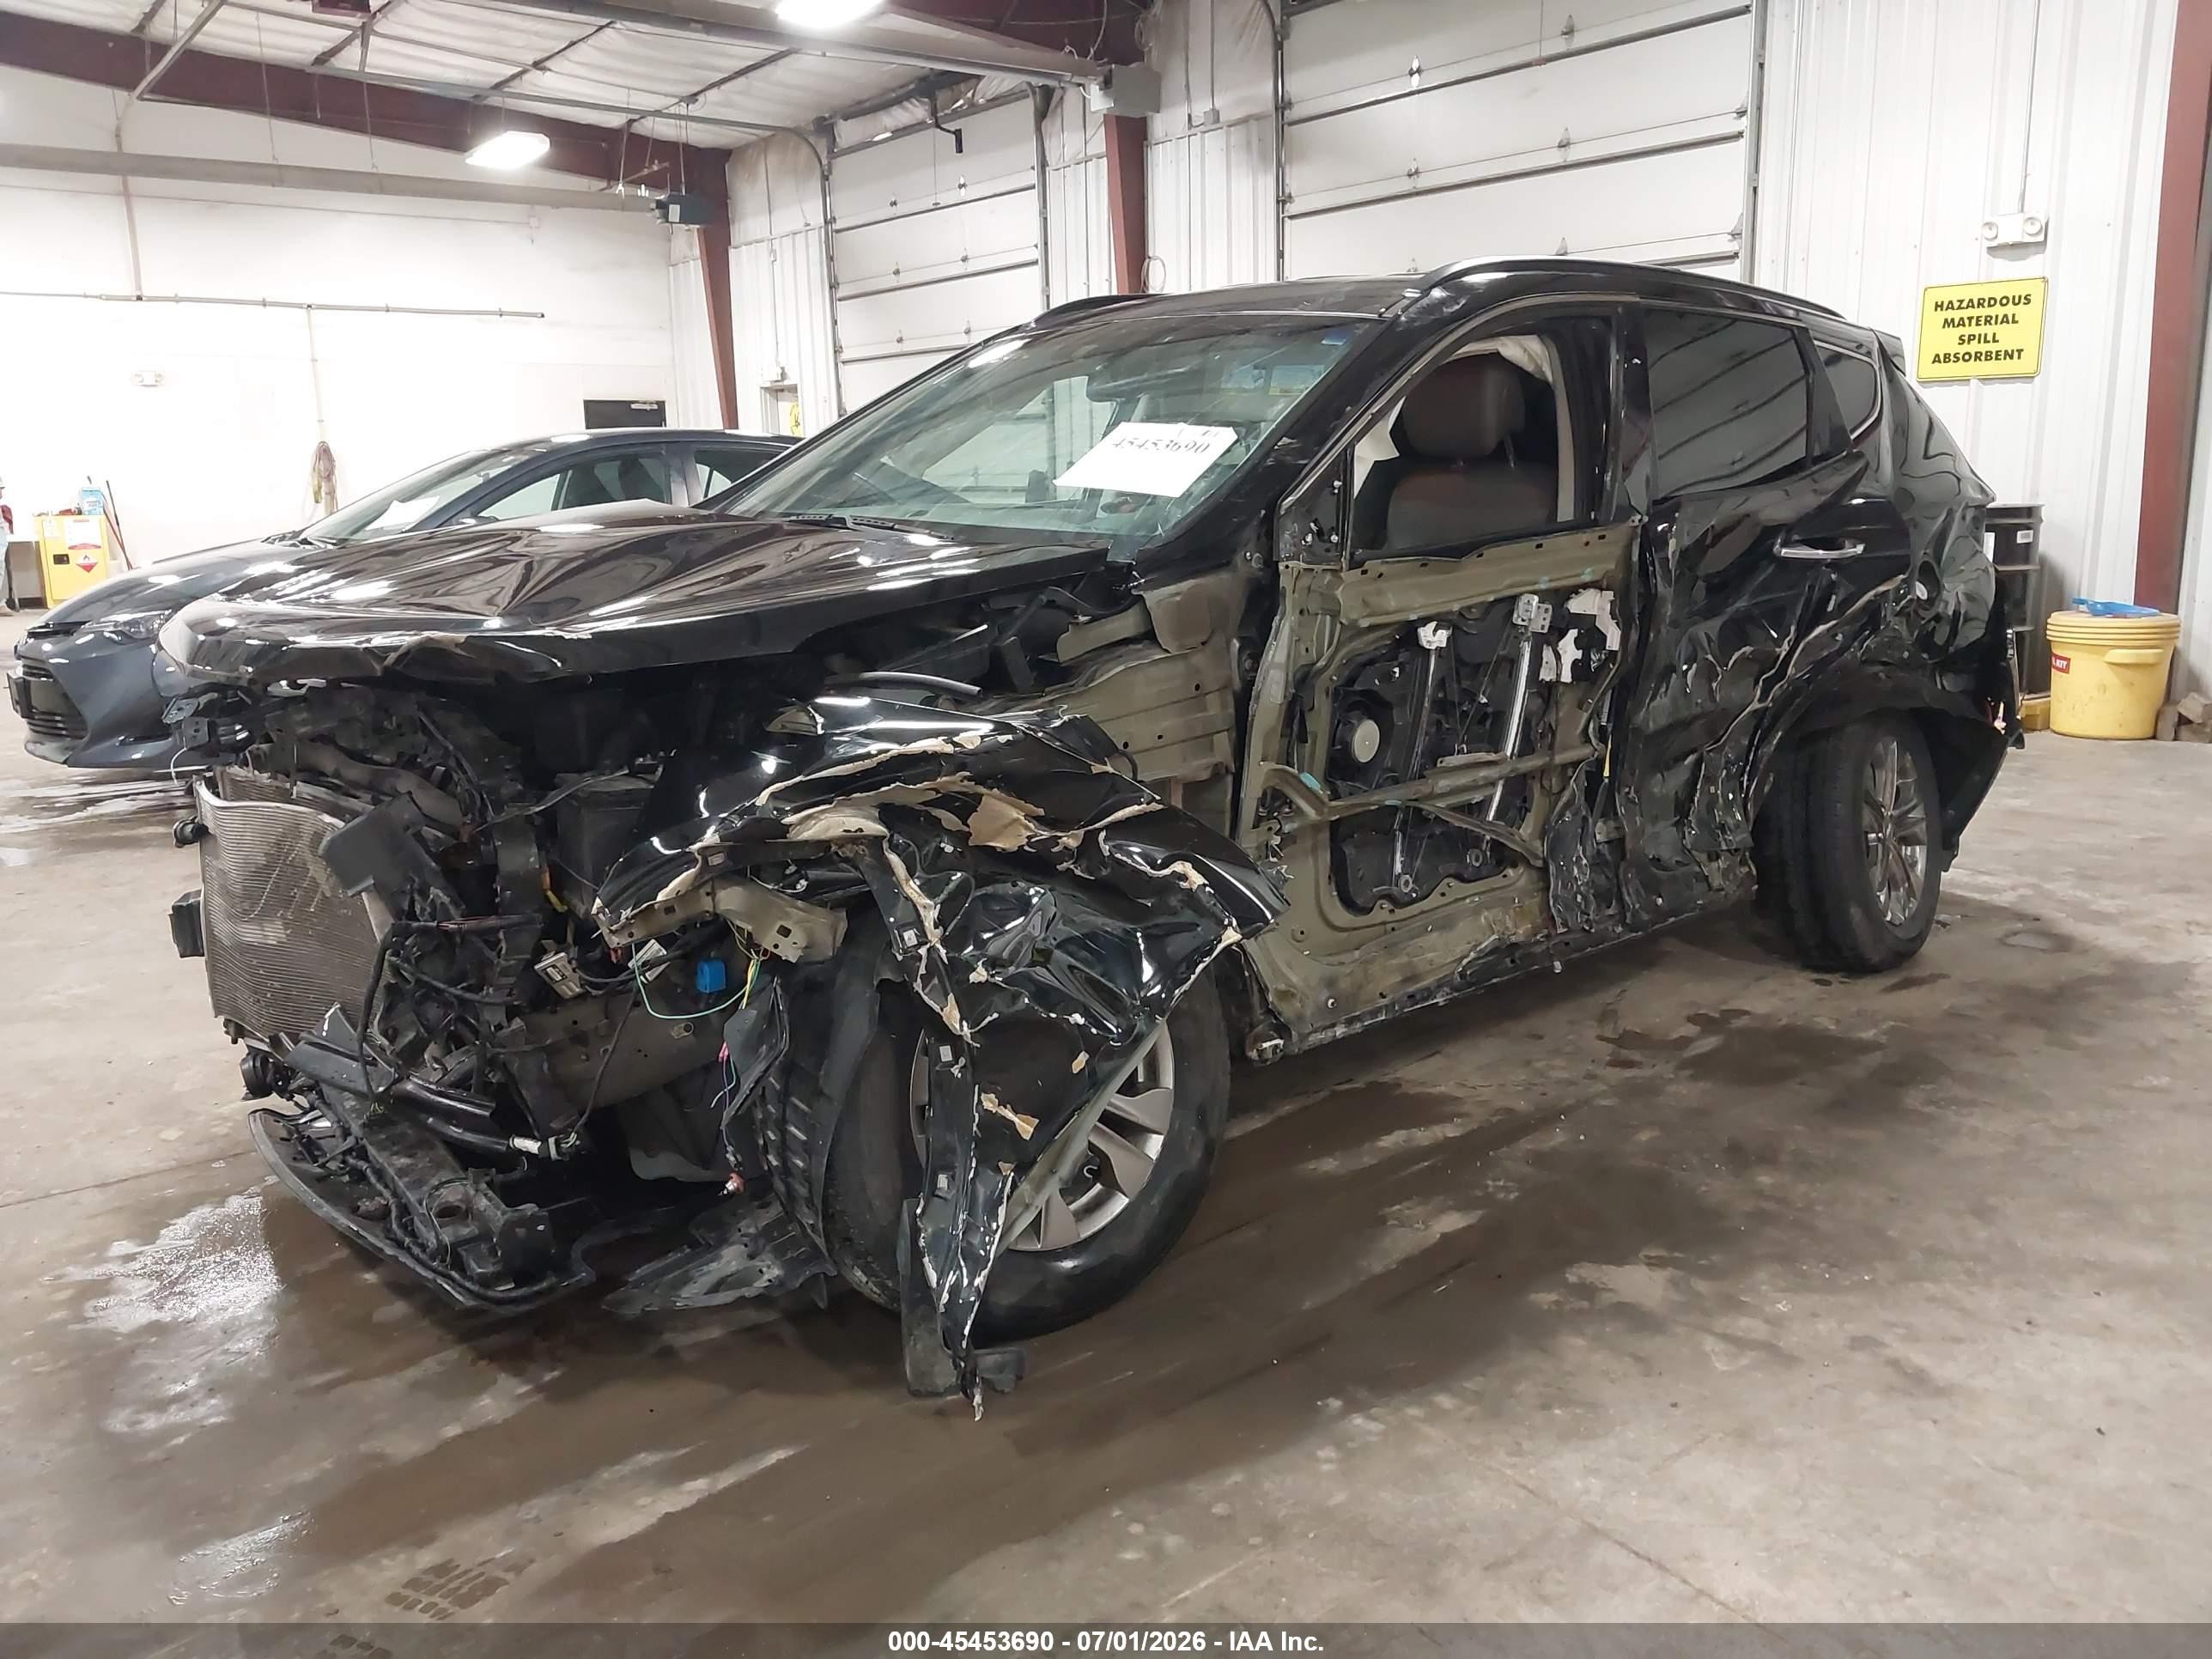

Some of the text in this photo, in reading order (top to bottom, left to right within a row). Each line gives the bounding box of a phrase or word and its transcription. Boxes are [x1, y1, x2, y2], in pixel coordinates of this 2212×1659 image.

[1934, 293, 2033, 313] HAZARDOUS
[1942, 313, 2020, 329] MATERIAL
[1957, 331, 2000, 346] SPILL
[1931, 348, 2025, 365] ABSORBENT
